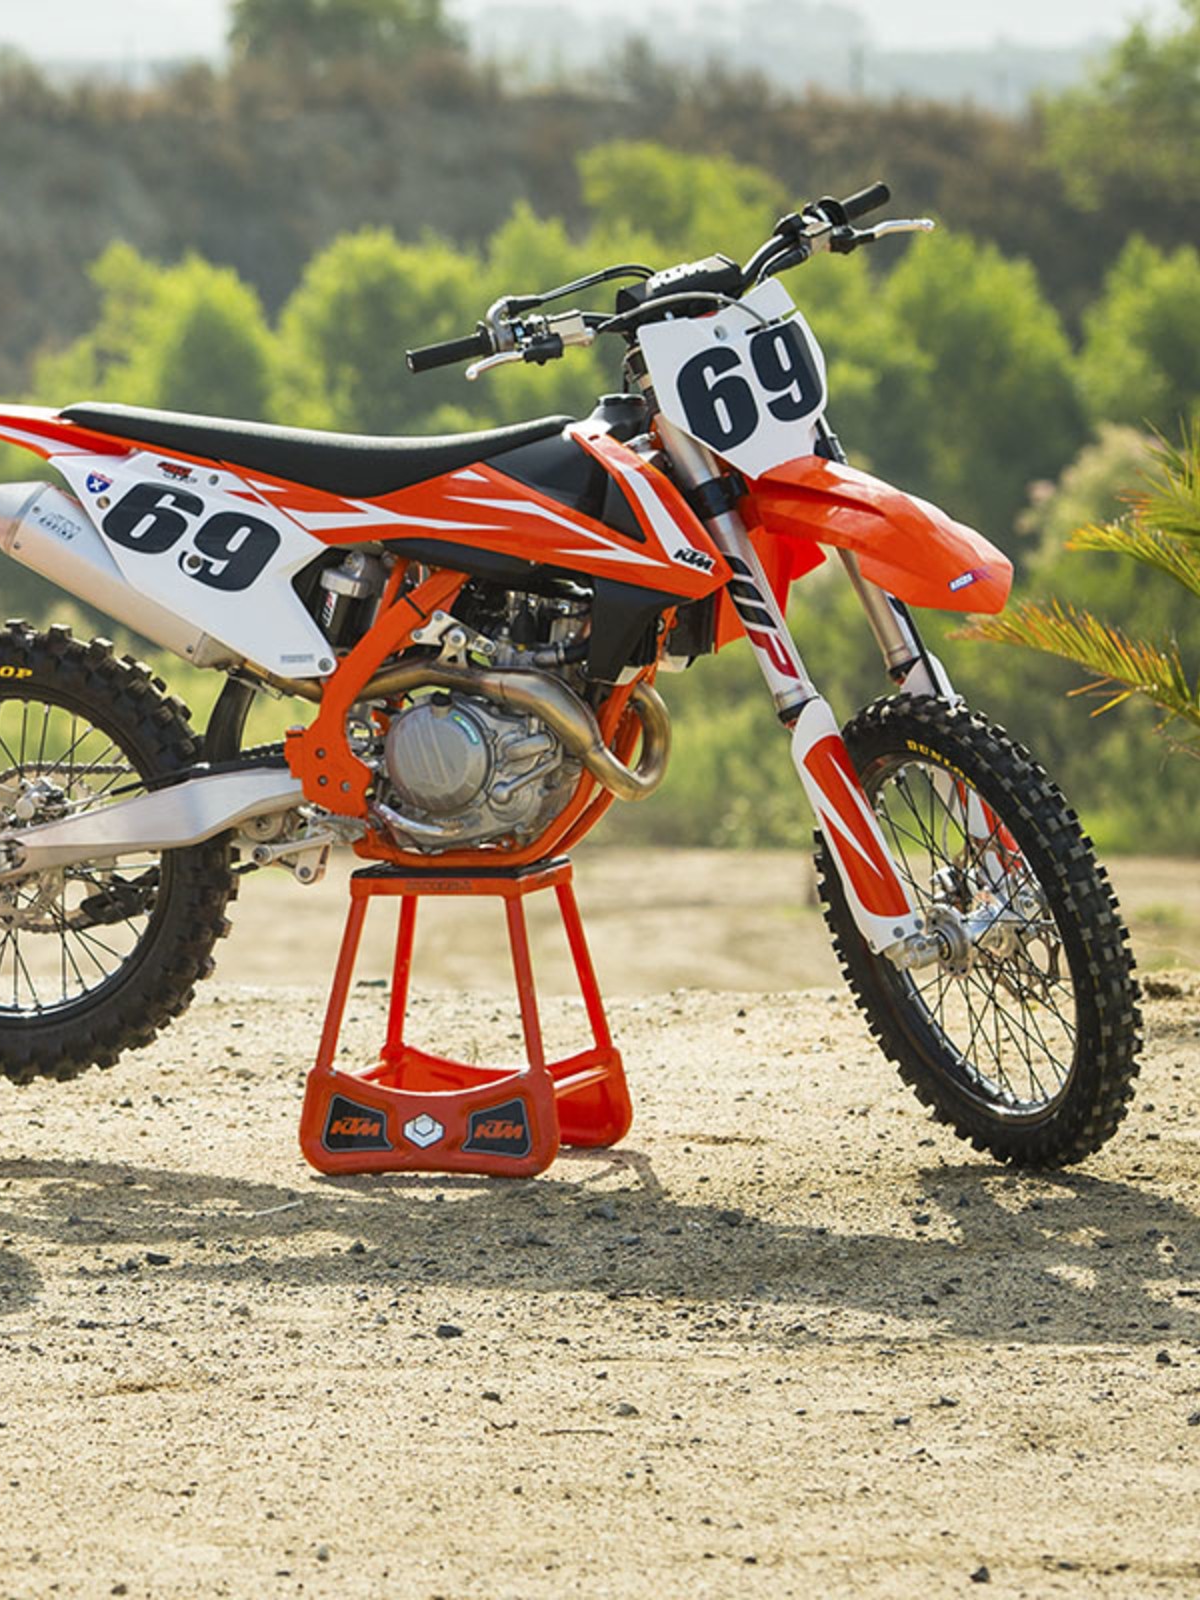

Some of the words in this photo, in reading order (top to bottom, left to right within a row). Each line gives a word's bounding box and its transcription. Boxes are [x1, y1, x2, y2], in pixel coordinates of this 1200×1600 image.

[677, 320, 822, 452] 69
[102, 482, 281, 592] 69
[674, 549, 713, 571] KTM
[906, 739, 977, 790] DUNLOP
[330, 1117, 381, 1137] KTM
[474, 1119, 524, 1139] KTM
